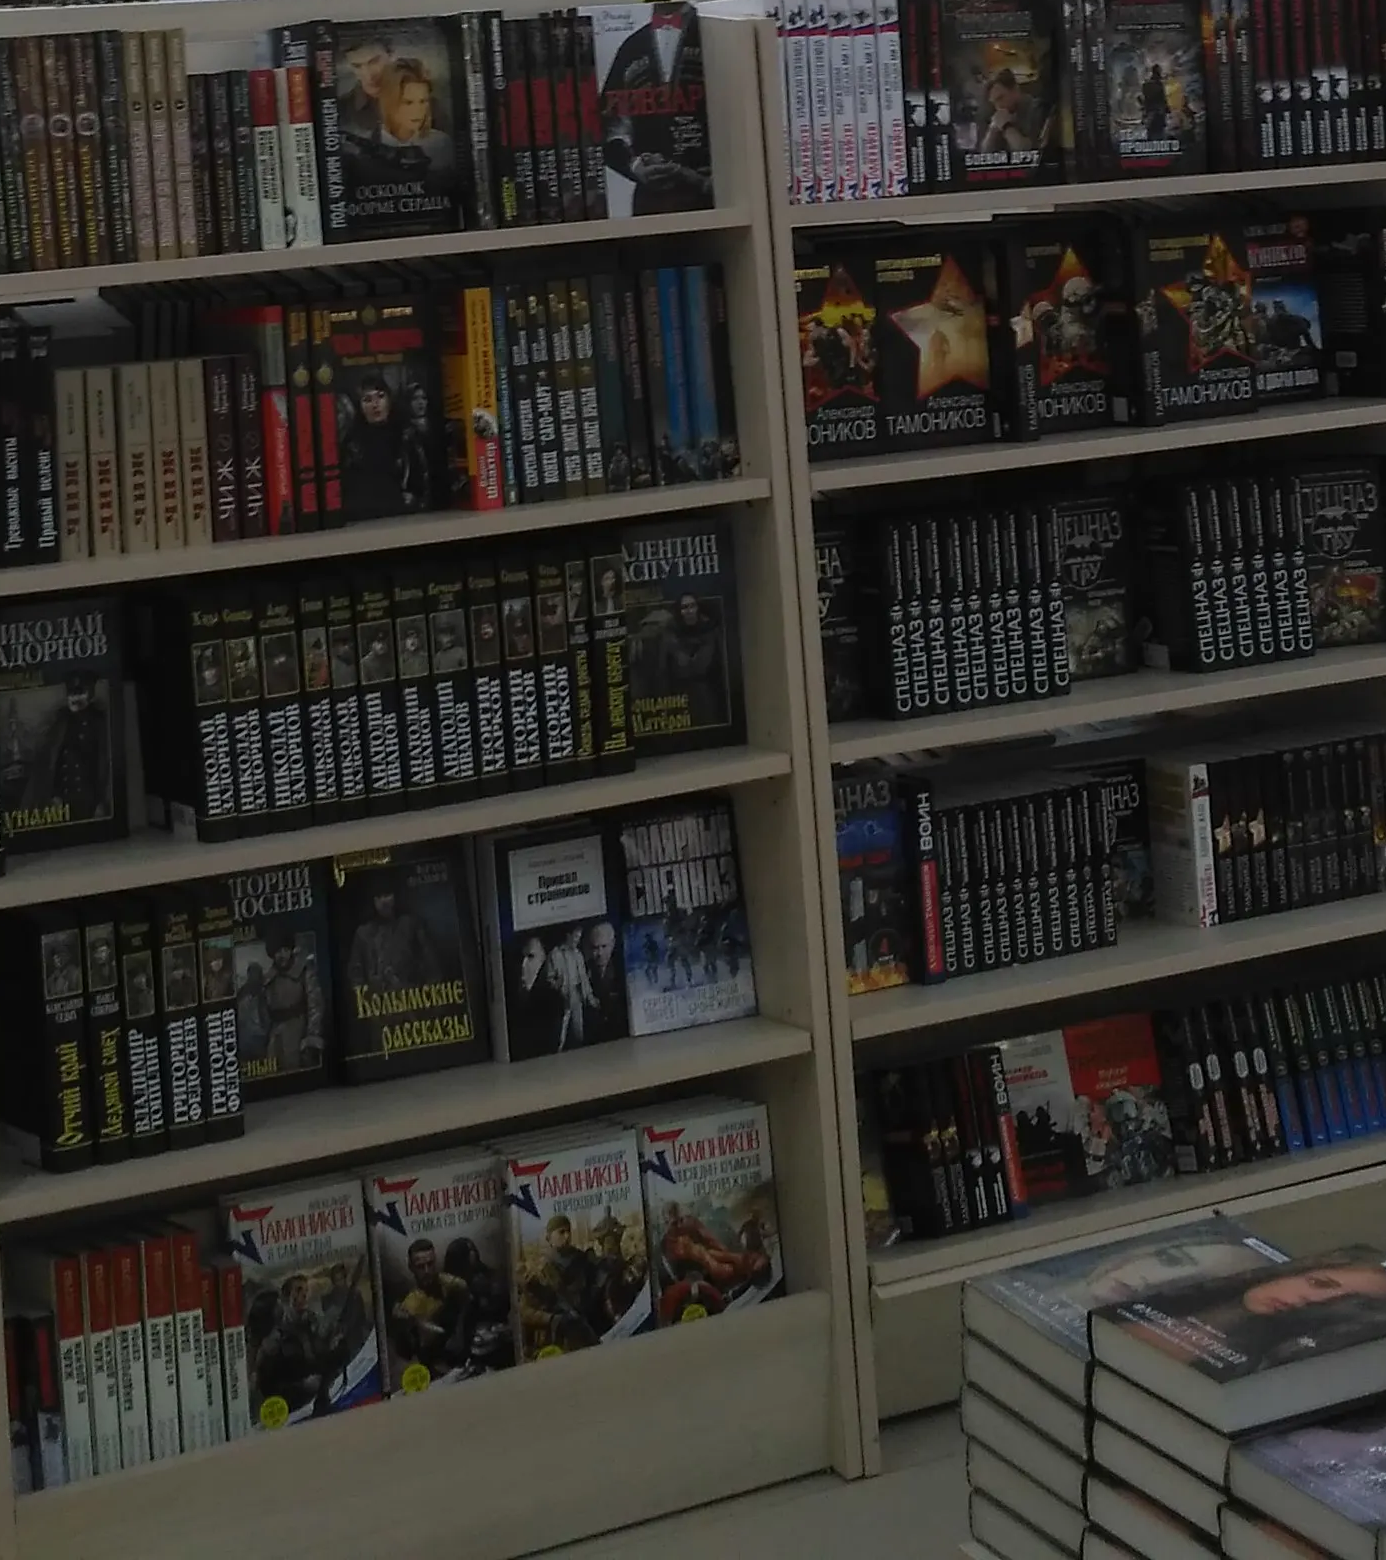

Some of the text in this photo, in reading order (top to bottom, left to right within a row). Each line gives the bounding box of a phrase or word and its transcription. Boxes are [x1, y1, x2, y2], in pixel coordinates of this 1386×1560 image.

[325, 144, 344, 194] ЧУЖИМ
[885, 407, 987, 437] ТАМОНИКОВ
[926, 393, 985, 410] Александр
[1162, 379, 1253, 410] ТАМОНИКОВ
[217, 455, 236, 521] ЧИЖ
[244, 454, 263, 517] ЧИЖ
[890, 623, 912, 713] СПЕЦНАЗ
[909, 618, 930, 707] СПЕЦНАЗ
[929, 616, 950, 705] СПЕЦНАЗ
[951, 615, 972, 704] СПЕЦНАЗ
[968, 612, 989, 701] СПЕЦНАЗ
[476, 676, 497, 772] ГЕОРГИЙ
[489, 678, 507, 770] МАРКОВ
[508, 669, 528, 766] ГЕОРГИЙ
[523, 671, 541, 763] МАРКОВ
[541, 664, 562, 760] ГЕОРГИЙ
[555, 665, 574, 757] МАРКОВ
[916, 792, 934, 851] ВОИН
[355, 978, 466, 1020] Колымские
[379, 1012, 471, 1061] рассказы
[127, 1028, 152, 1134] ВЛАДИМИР
[166, 1019, 190, 1124] ГРИГОРИЙ
[182, 1015, 204, 1123] ФЕДОСЕЕВ
[205, 1010, 229, 1115] ГРИГОРИЙ
[221, 1007, 241, 1113] ФЕДОСЕЕВ
[989, 1052, 1009, 1105] ВОИН
[258, 1206, 354, 1245] ТАМОНИКОВ
